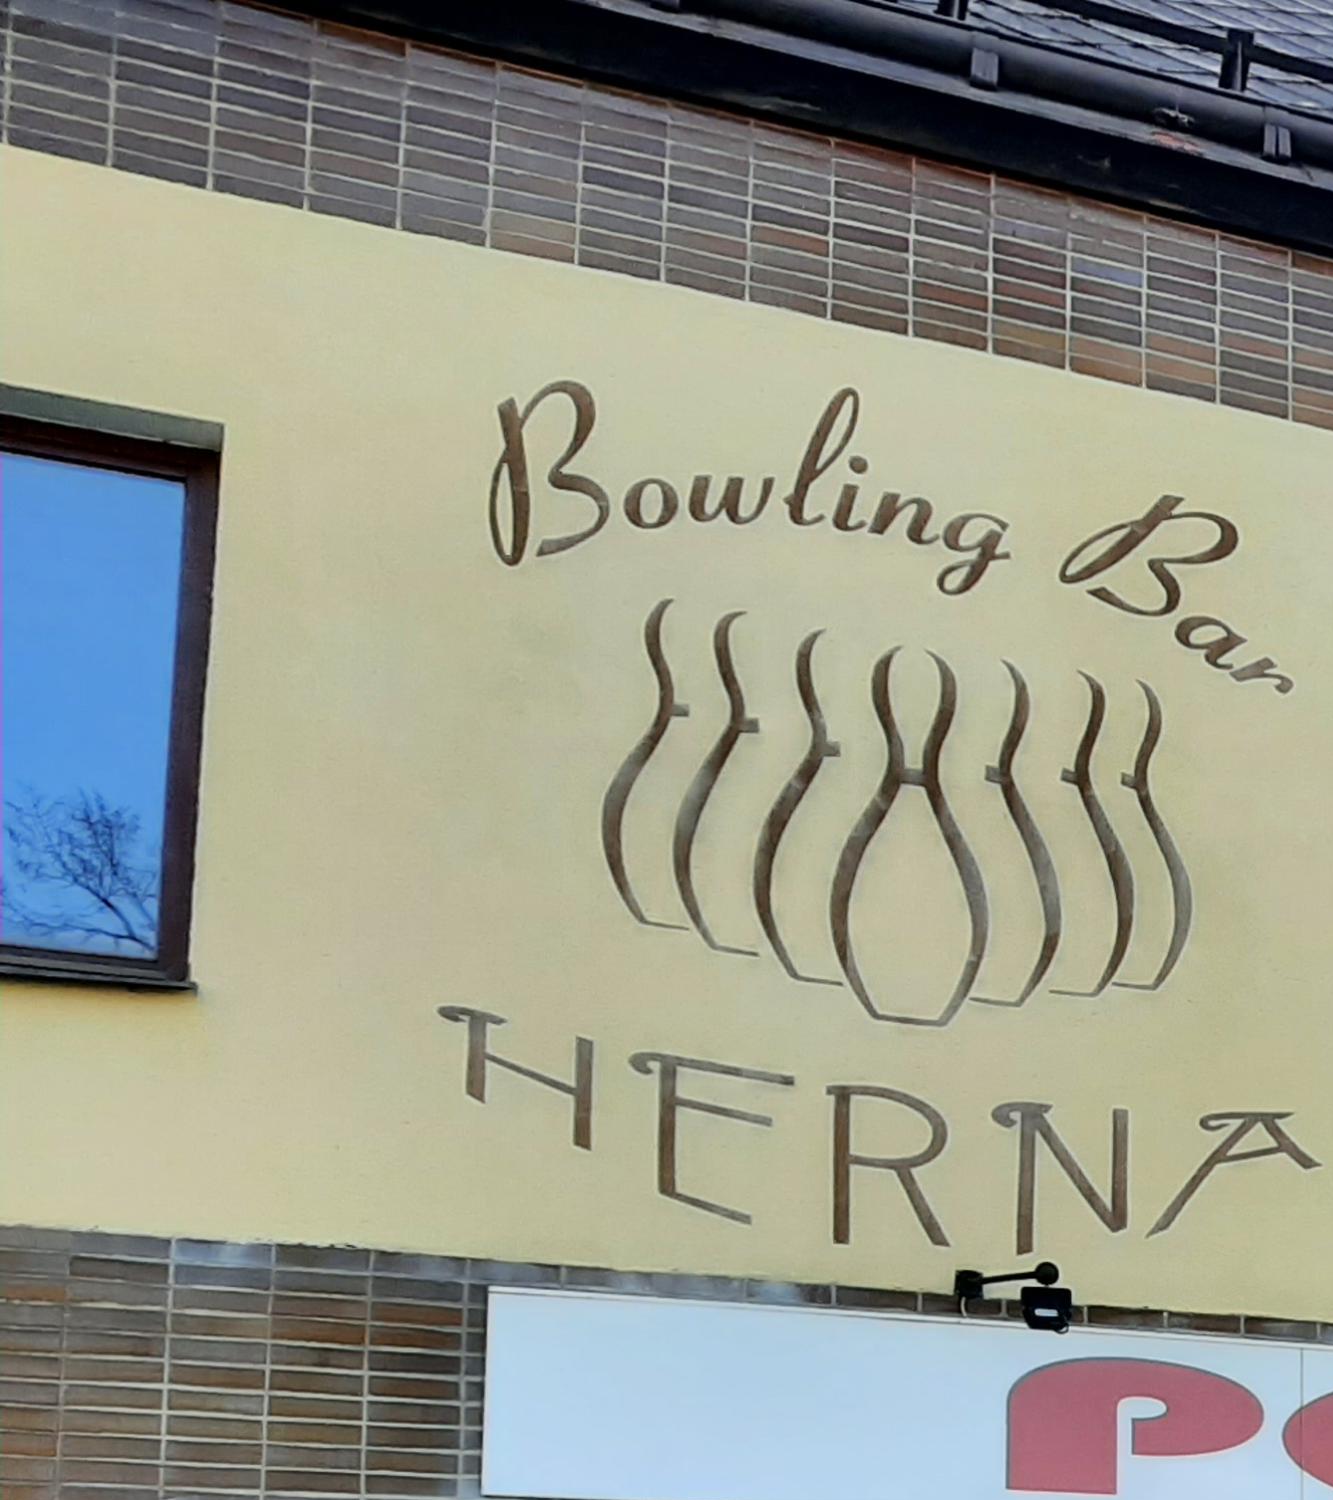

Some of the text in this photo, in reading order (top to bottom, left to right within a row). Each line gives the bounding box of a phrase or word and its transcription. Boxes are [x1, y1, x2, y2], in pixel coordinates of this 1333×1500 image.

[488, 380, 1294, 695] Bowling Bar
[437, 1005, 1323, 1257] HERNA
